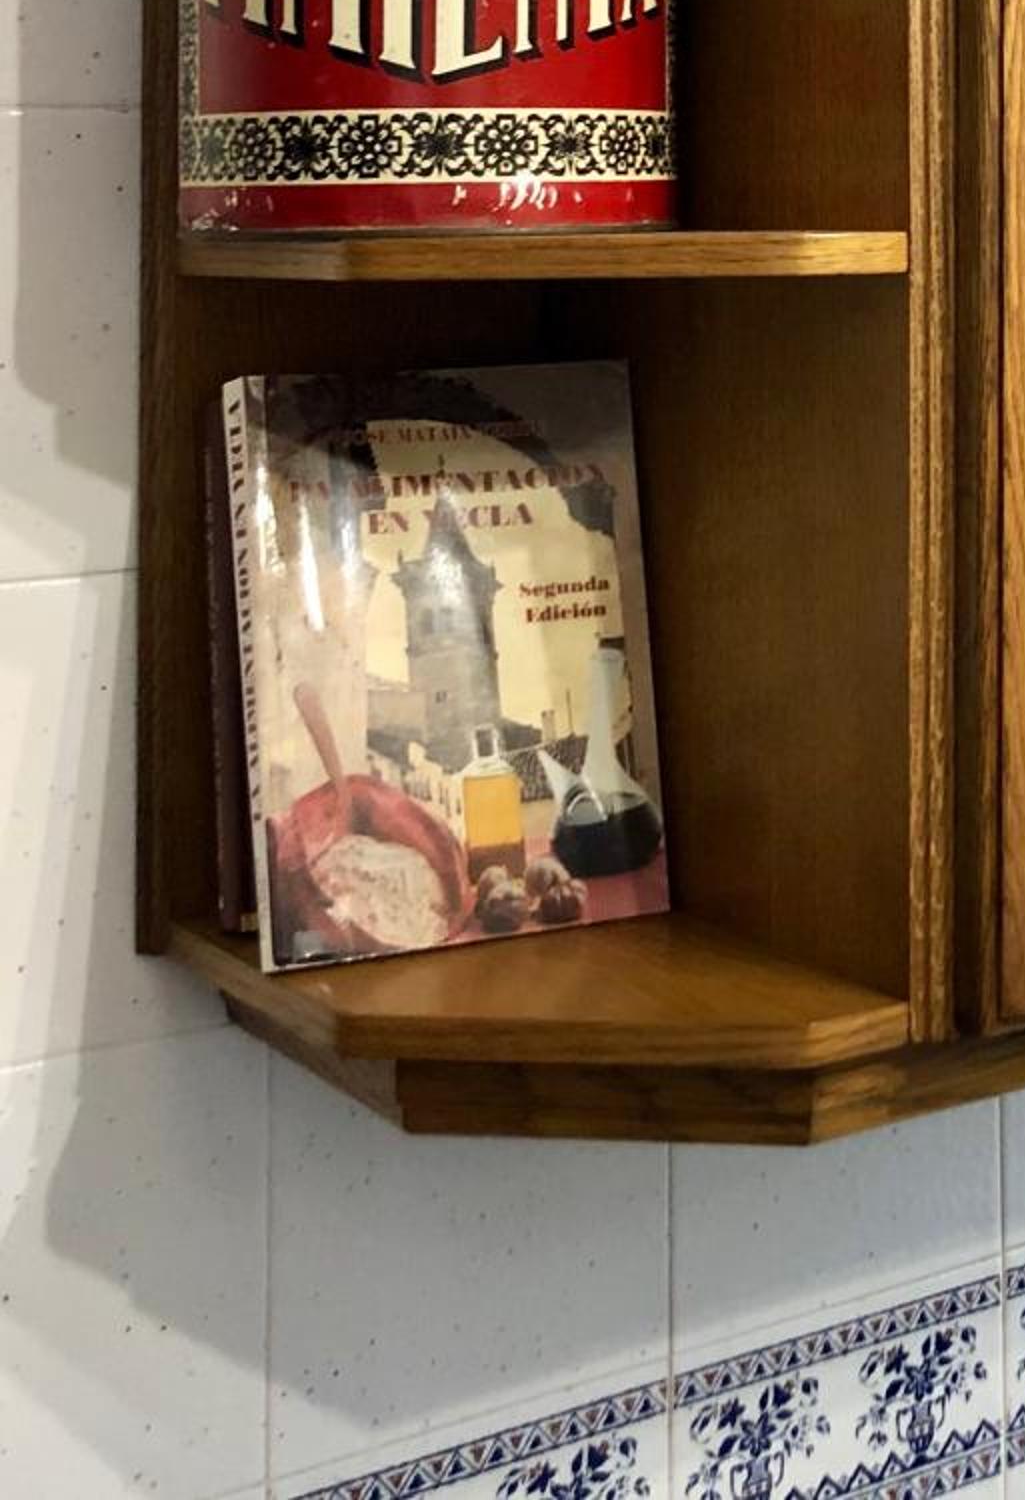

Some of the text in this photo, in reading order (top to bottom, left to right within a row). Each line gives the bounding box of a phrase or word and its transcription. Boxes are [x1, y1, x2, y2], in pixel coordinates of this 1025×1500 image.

[228, 401, 245, 493] YECLA
[367, 511, 409, 535] EN
[520, 576, 610, 598] Segunda
[526, 601, 607, 622] Edición
